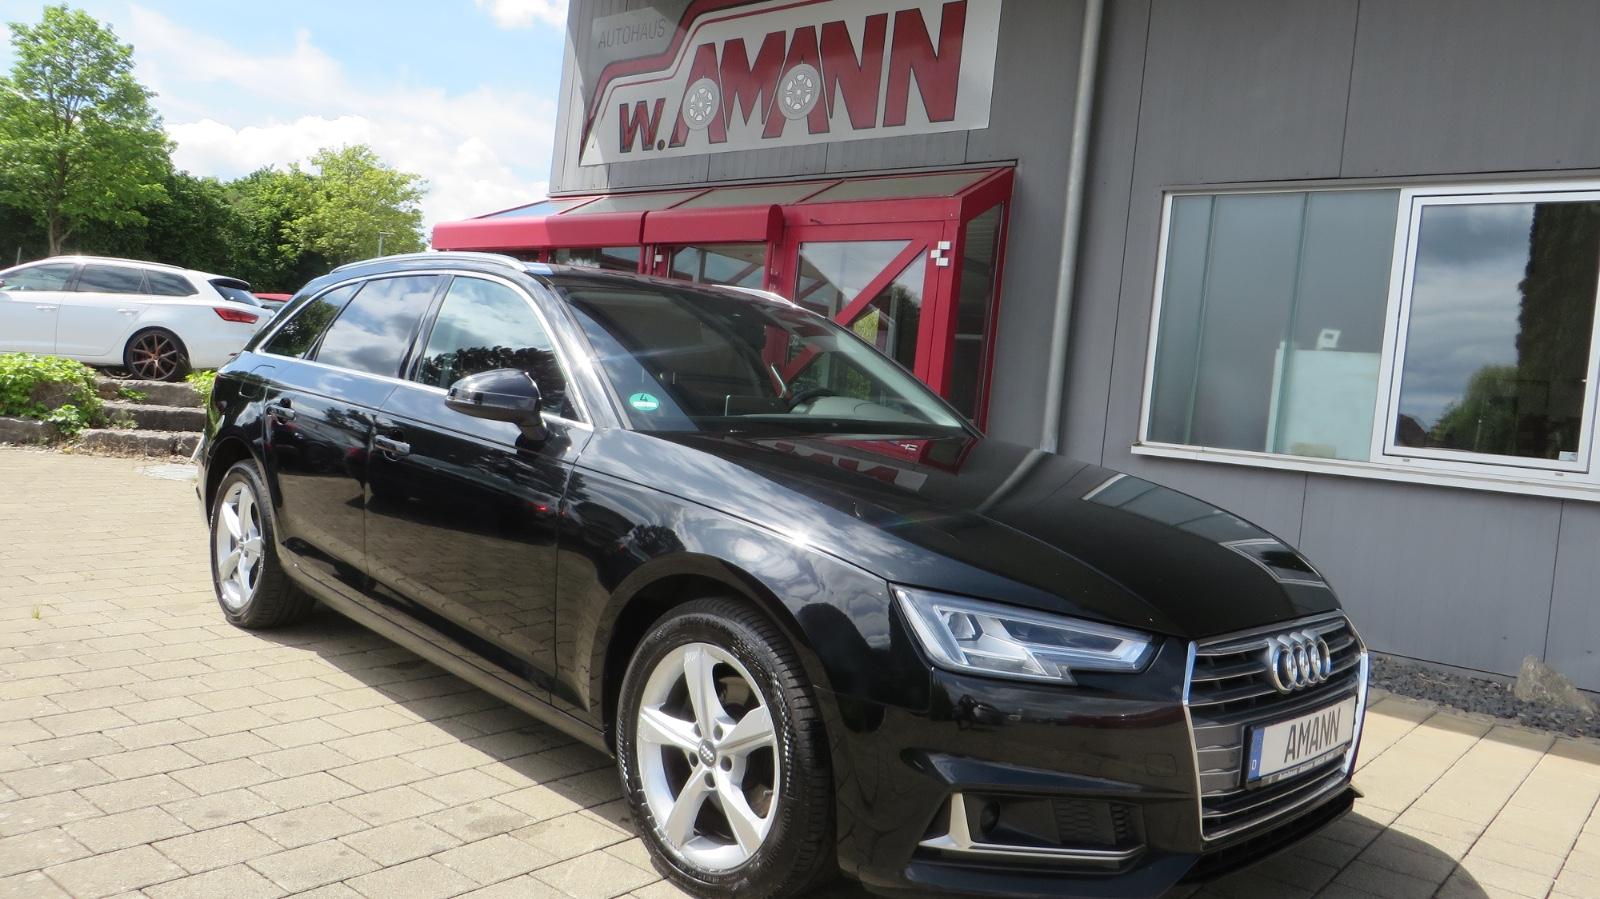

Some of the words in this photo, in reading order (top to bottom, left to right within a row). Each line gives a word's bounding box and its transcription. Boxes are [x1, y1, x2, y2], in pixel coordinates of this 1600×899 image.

[598, 18, 666, 48] AUTOHAUS
[668, 0, 967, 148] AMANN
[639, 393, 648, 402] 4
[1283, 707, 1341, 763] AMANN
[1251, 760, 1257, 770] D
